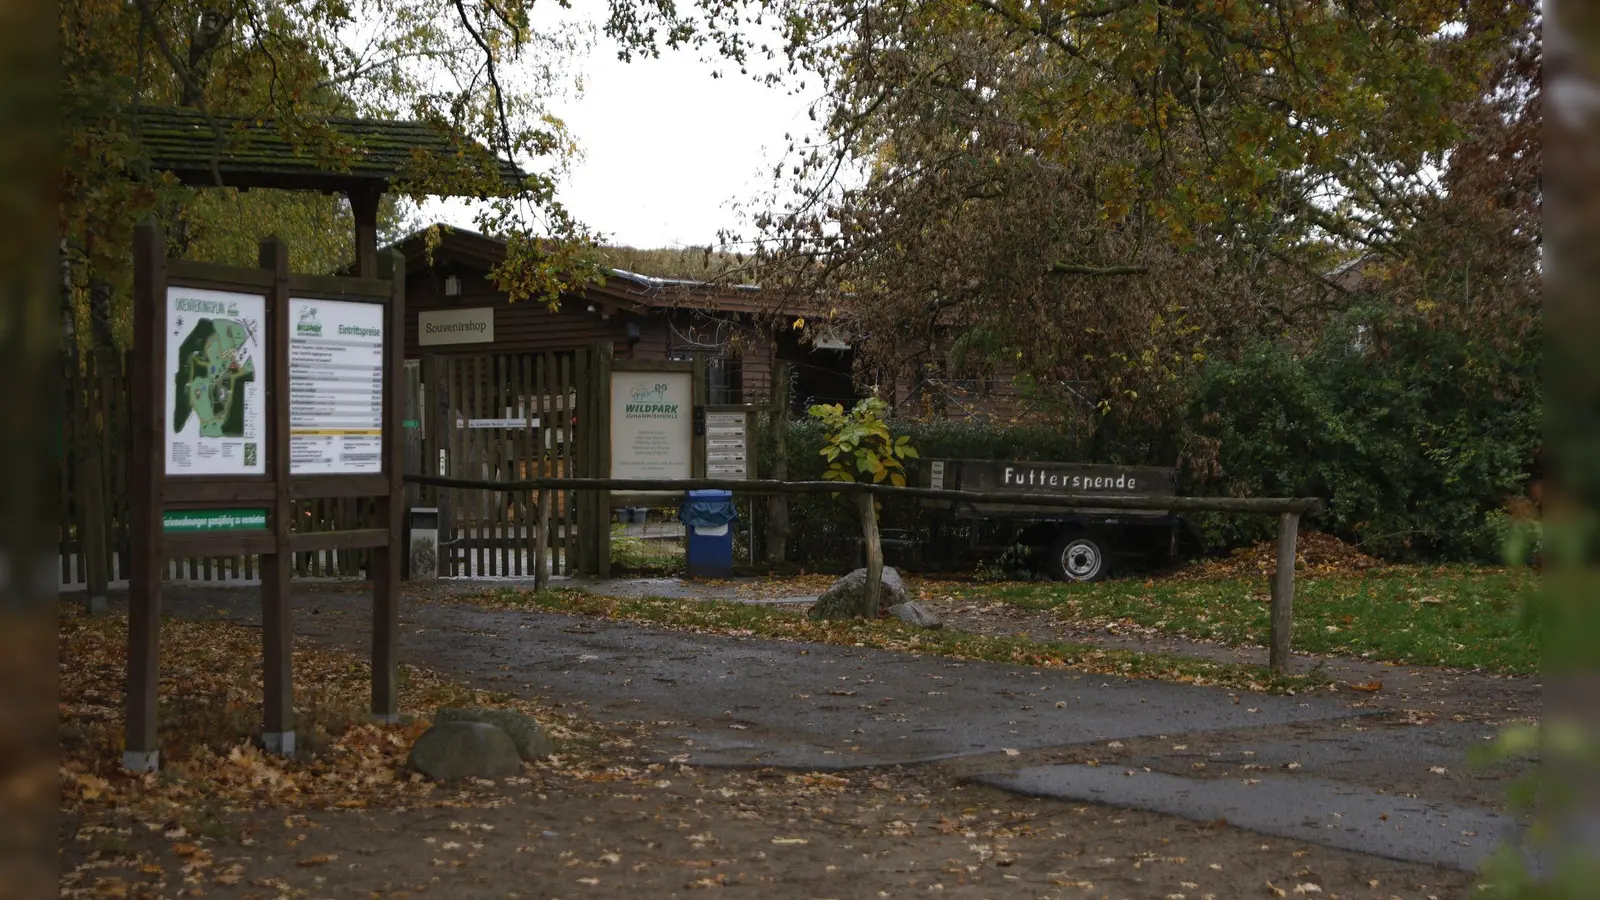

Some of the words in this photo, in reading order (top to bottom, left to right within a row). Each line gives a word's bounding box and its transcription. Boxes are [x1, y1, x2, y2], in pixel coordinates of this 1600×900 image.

[338, 324, 380, 338] Eintrittspreise
[425, 320, 487, 334] Souvenirshop
[625, 404, 679, 413] WILDPARK
[1005, 467, 1136, 490] Futterspende
